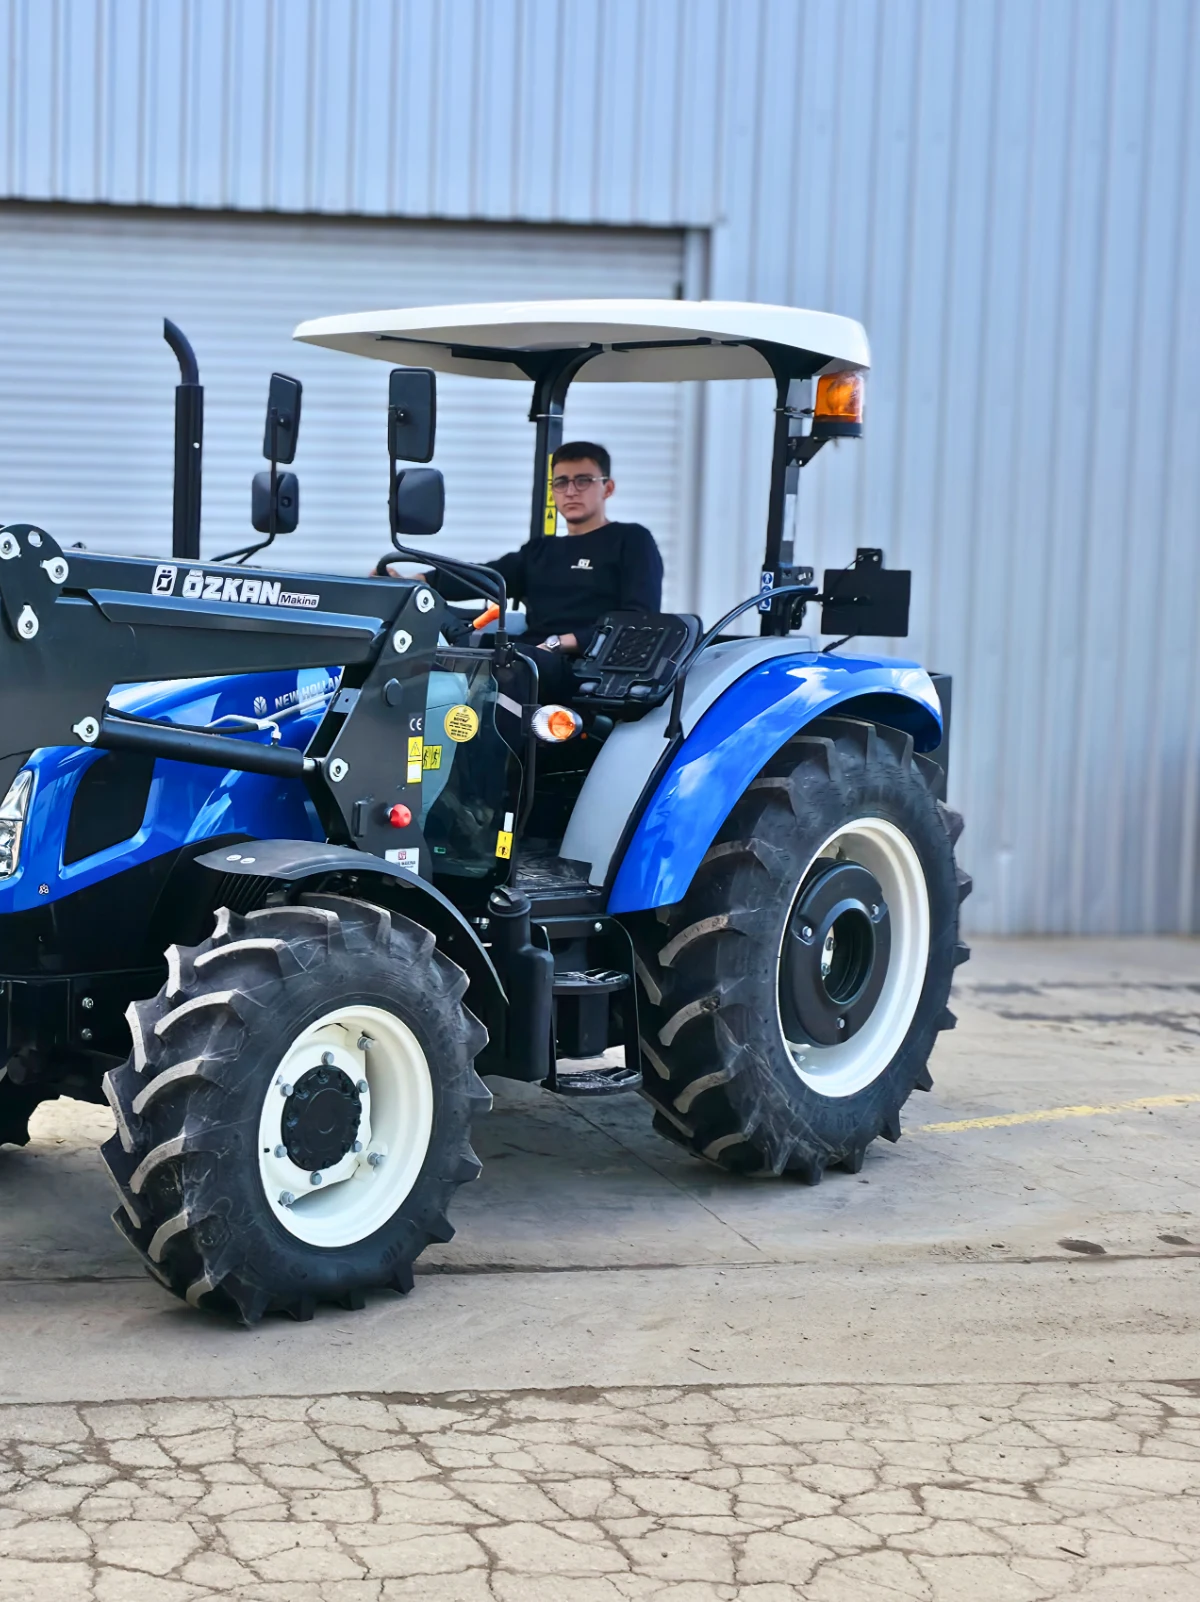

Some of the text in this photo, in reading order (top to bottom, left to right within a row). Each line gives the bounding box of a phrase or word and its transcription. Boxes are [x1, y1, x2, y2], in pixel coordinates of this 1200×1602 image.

[182, 569, 282, 605] ÖZKAN
[280, 595, 318, 607] Makina
[275, 690, 299, 709] NEW
[409, 717, 422, 731] CE
